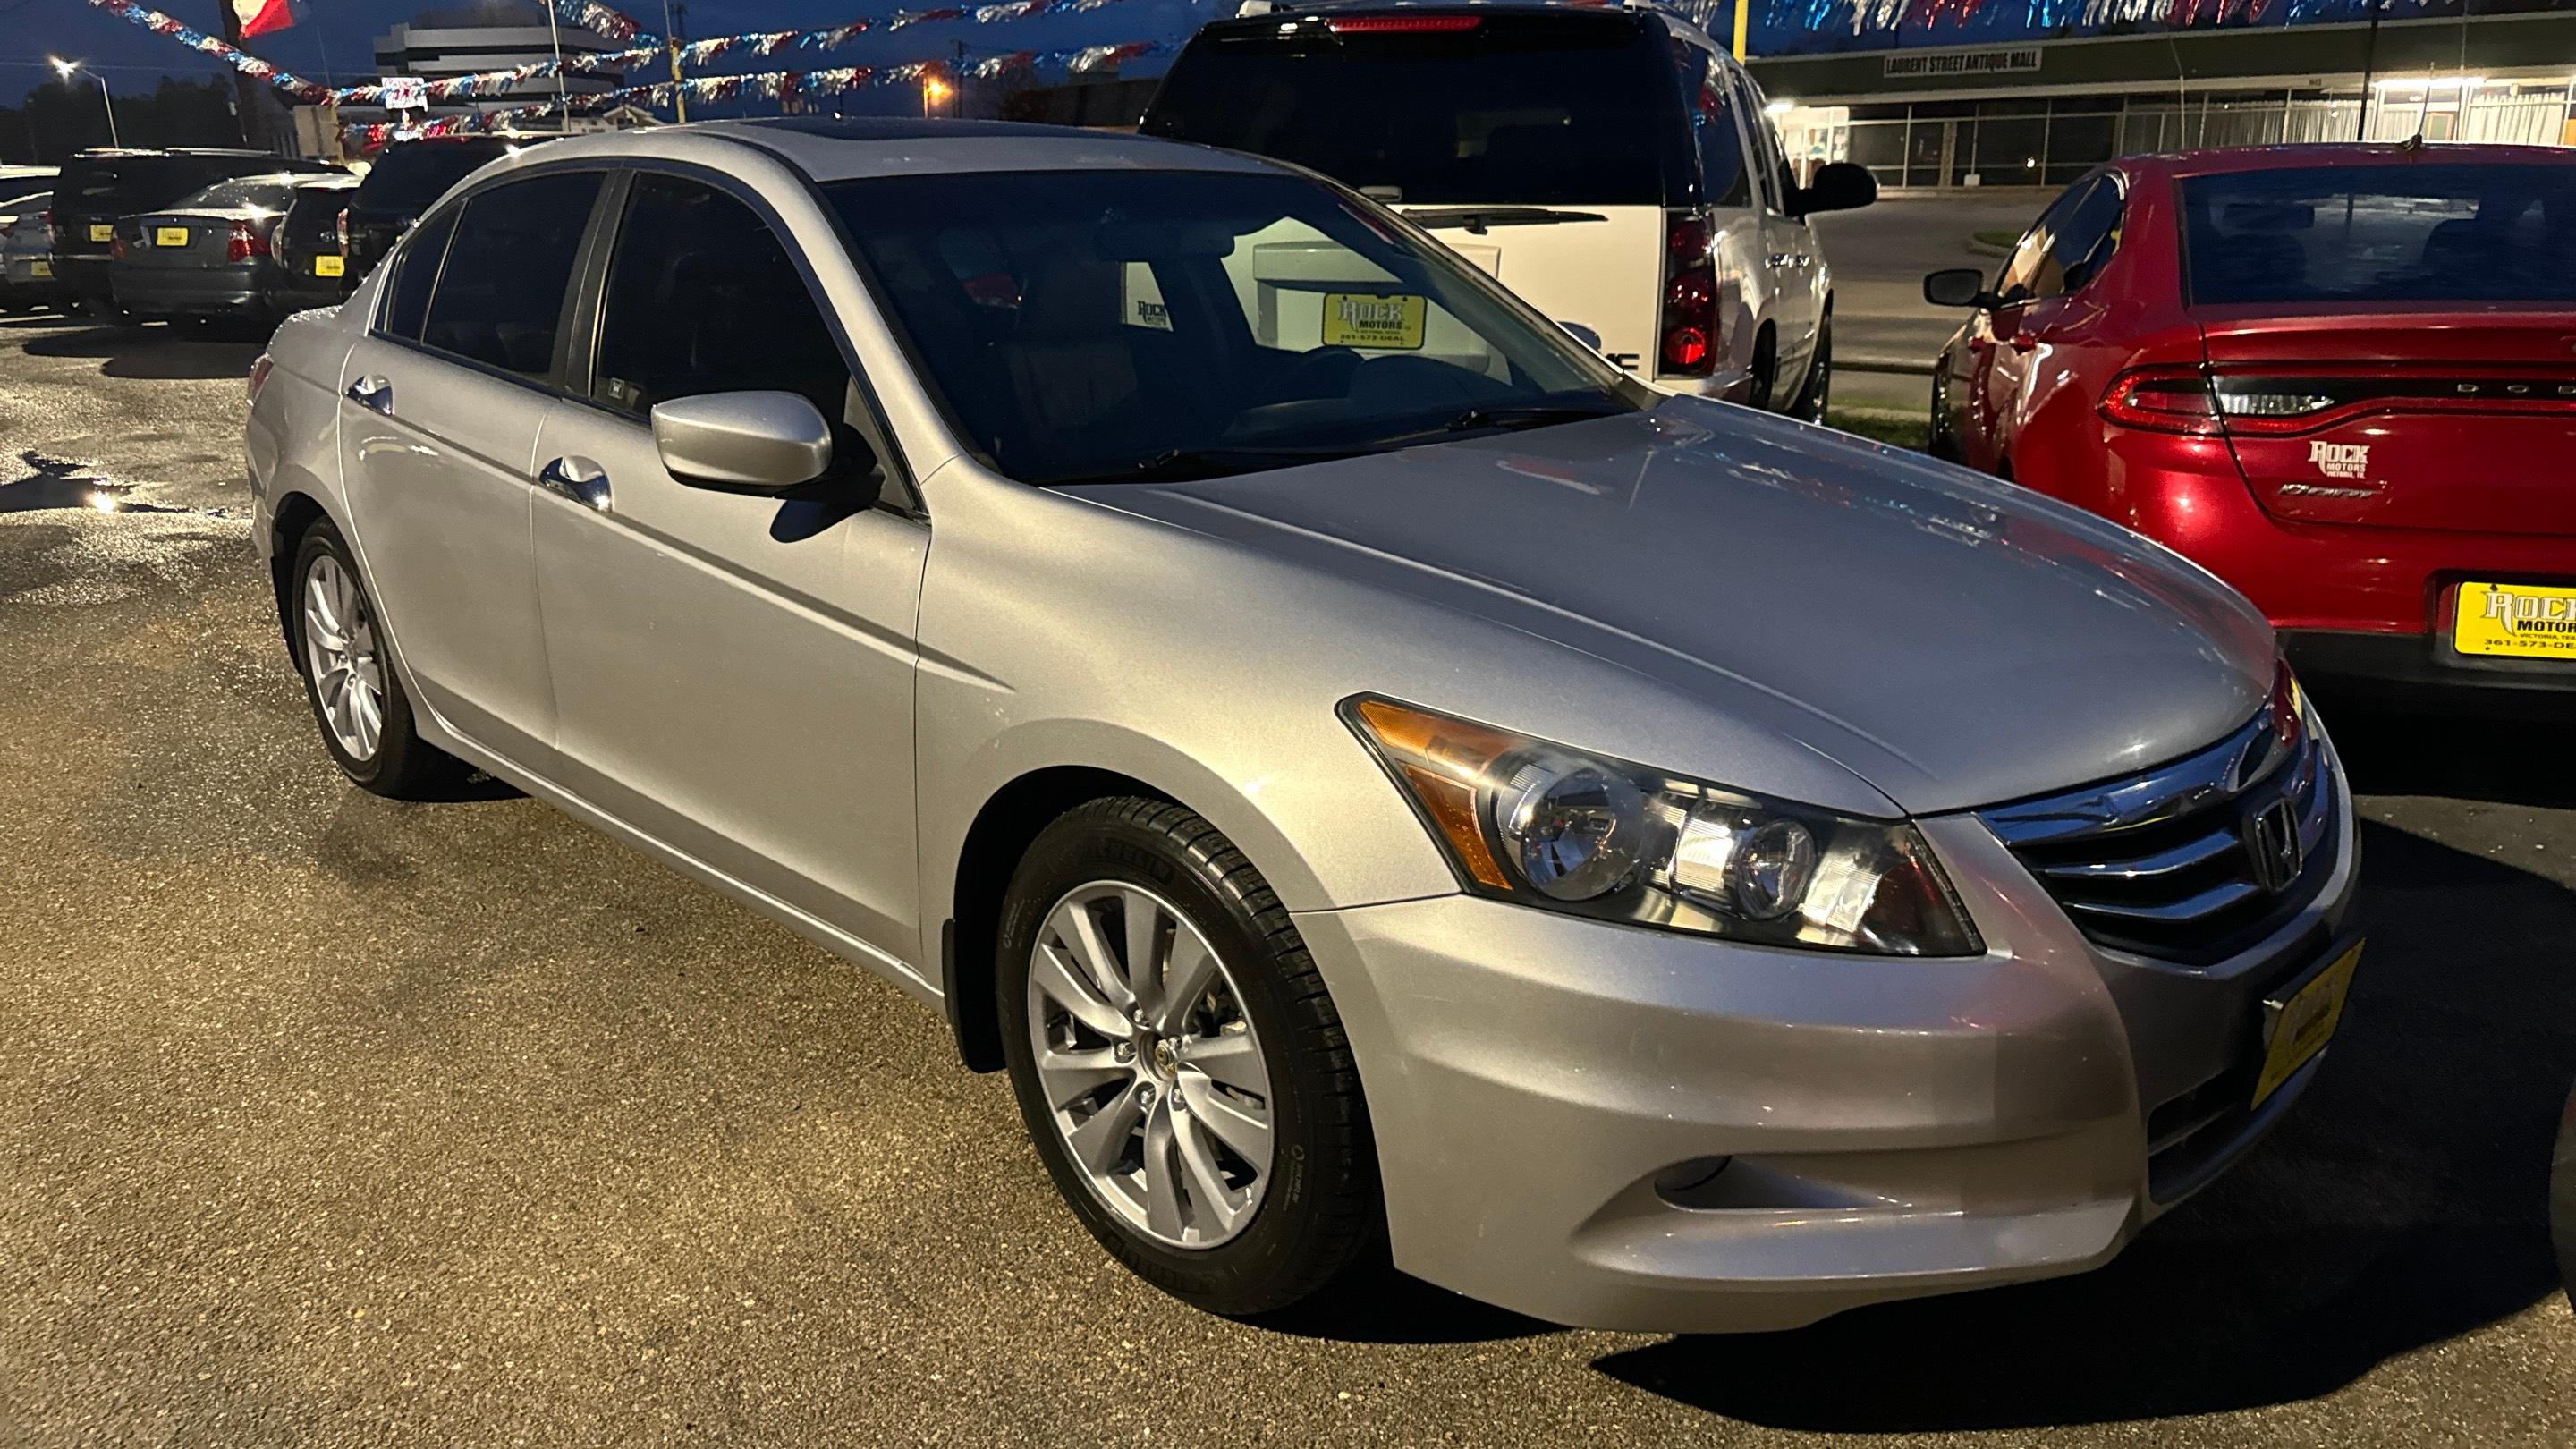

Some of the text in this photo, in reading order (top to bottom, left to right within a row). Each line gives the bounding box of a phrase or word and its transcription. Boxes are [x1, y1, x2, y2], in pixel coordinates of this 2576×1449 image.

[1886, 51, 2036, 73] LAURENT STREET ANTIQUE MALL
[1338, 301, 1404, 333] ROCK
[1359, 320, 1402, 329] MOTORS
[2308, 440, 2370, 475] ROCK
[2326, 463, 2366, 472] MOTORS
